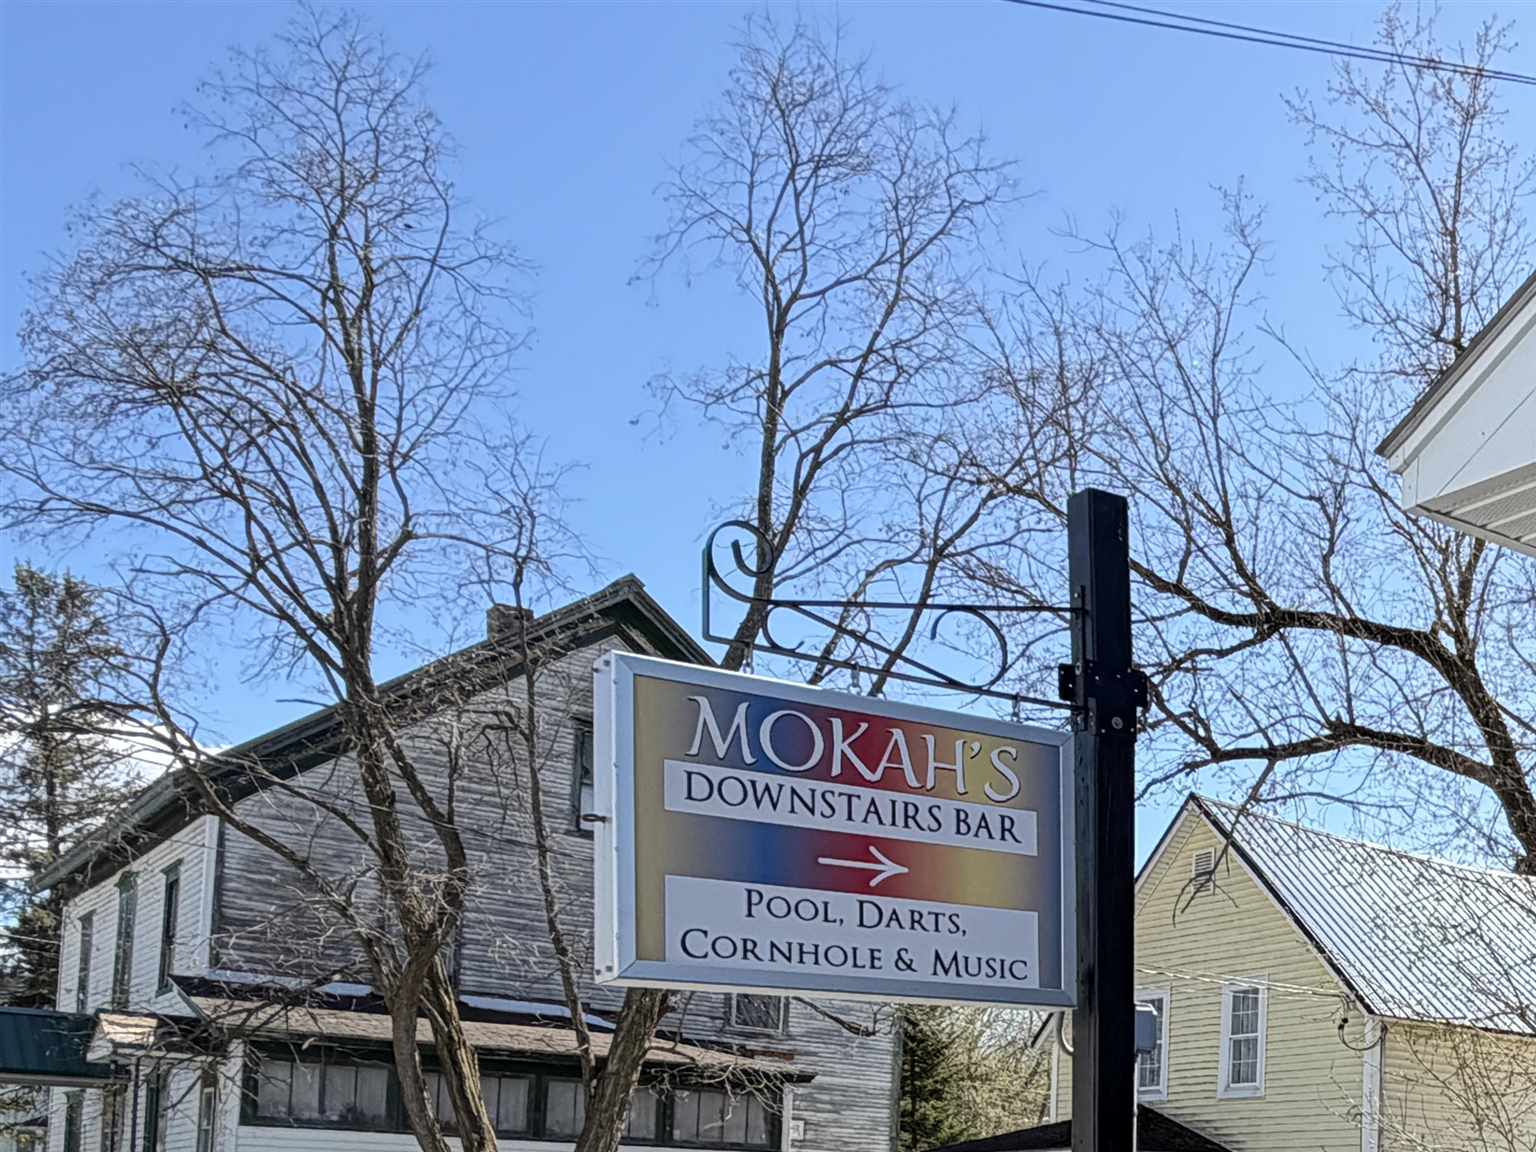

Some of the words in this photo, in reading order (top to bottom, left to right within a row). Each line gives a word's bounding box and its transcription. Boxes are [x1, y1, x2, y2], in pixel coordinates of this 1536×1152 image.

[684, 695, 1021, 803] MOKAH'S
[683, 769, 943, 833] DOWNSTAIRS
[953, 807, 1023, 844] BAR
[744, 887, 845, 926] POOL,
[855, 899, 968, 937] DARTS,
[680, 927, 884, 971] CORNHOLE
[893, 947, 919, 973] &
[930, 948, 1029, 981] MUSIC
